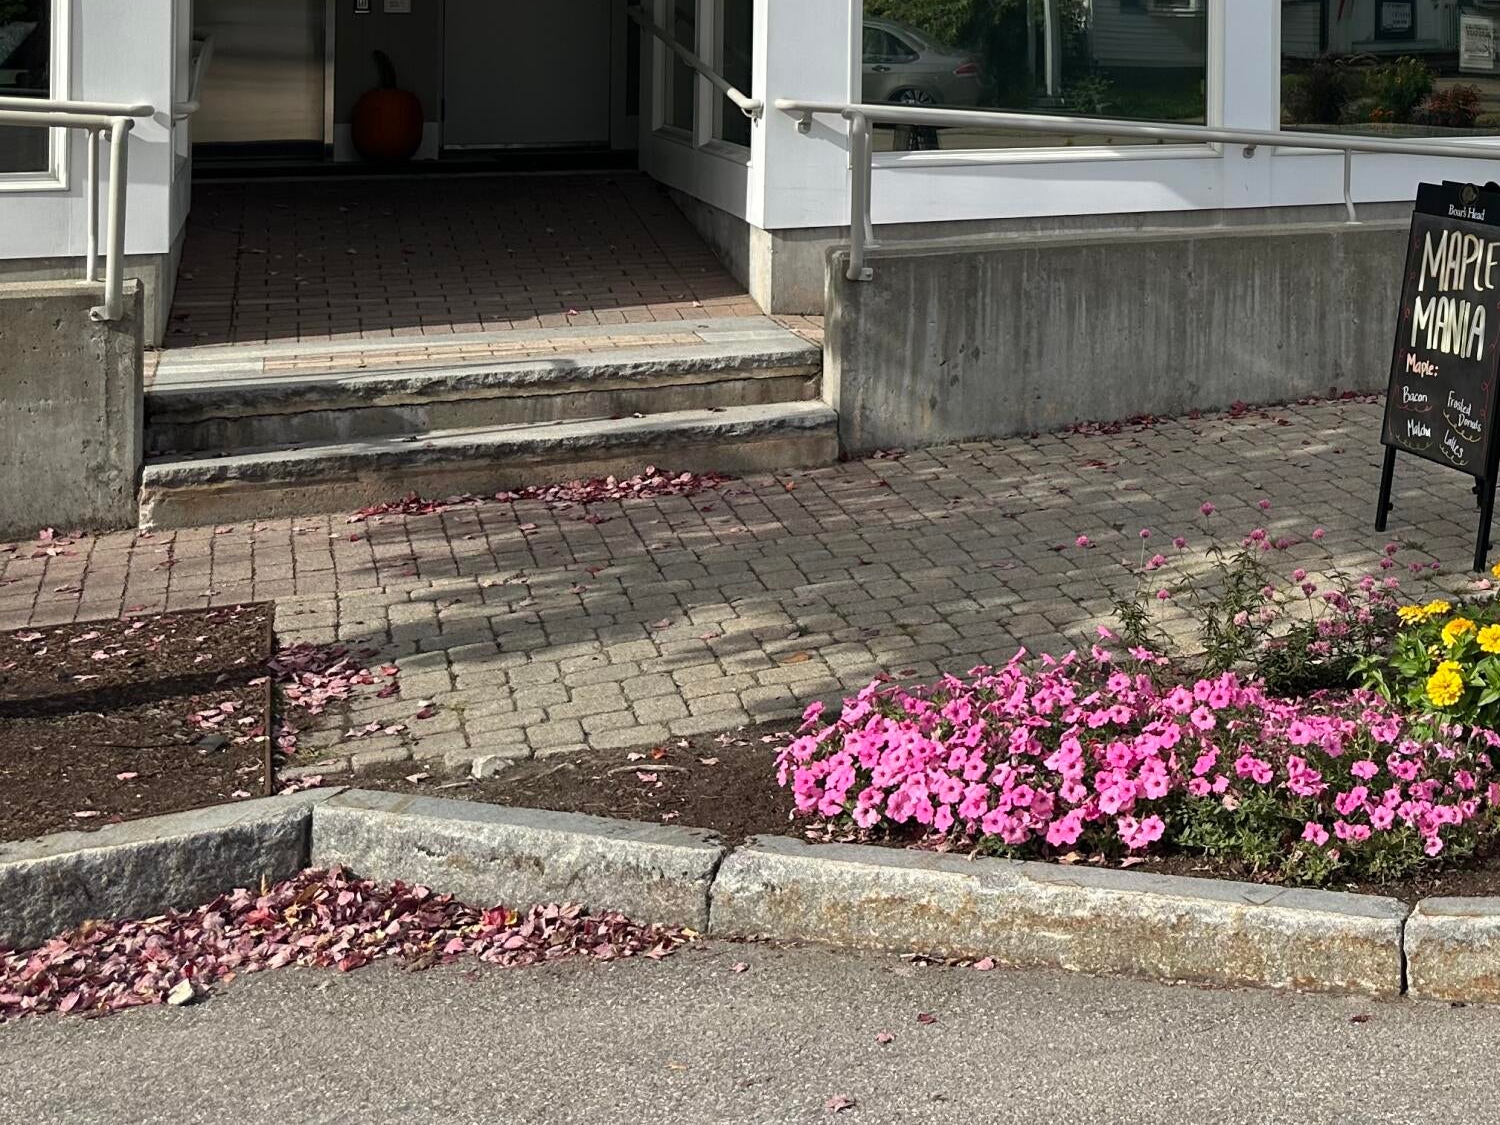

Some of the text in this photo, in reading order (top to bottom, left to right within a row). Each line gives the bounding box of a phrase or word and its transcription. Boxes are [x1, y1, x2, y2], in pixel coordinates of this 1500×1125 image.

[1467, 207, 1486, 221] Head
[1410, 295, 1487, 362] MANIA
[1406, 353, 1439, 377] Maple:
[1402, 386, 1428, 404] Bacon
[1447, 390, 1472, 415] Frosted
[1407, 419, 1432, 437] Matcha
[1458, 413, 1482, 432] Donuts
[1443, 429, 1464, 458] Lattes
